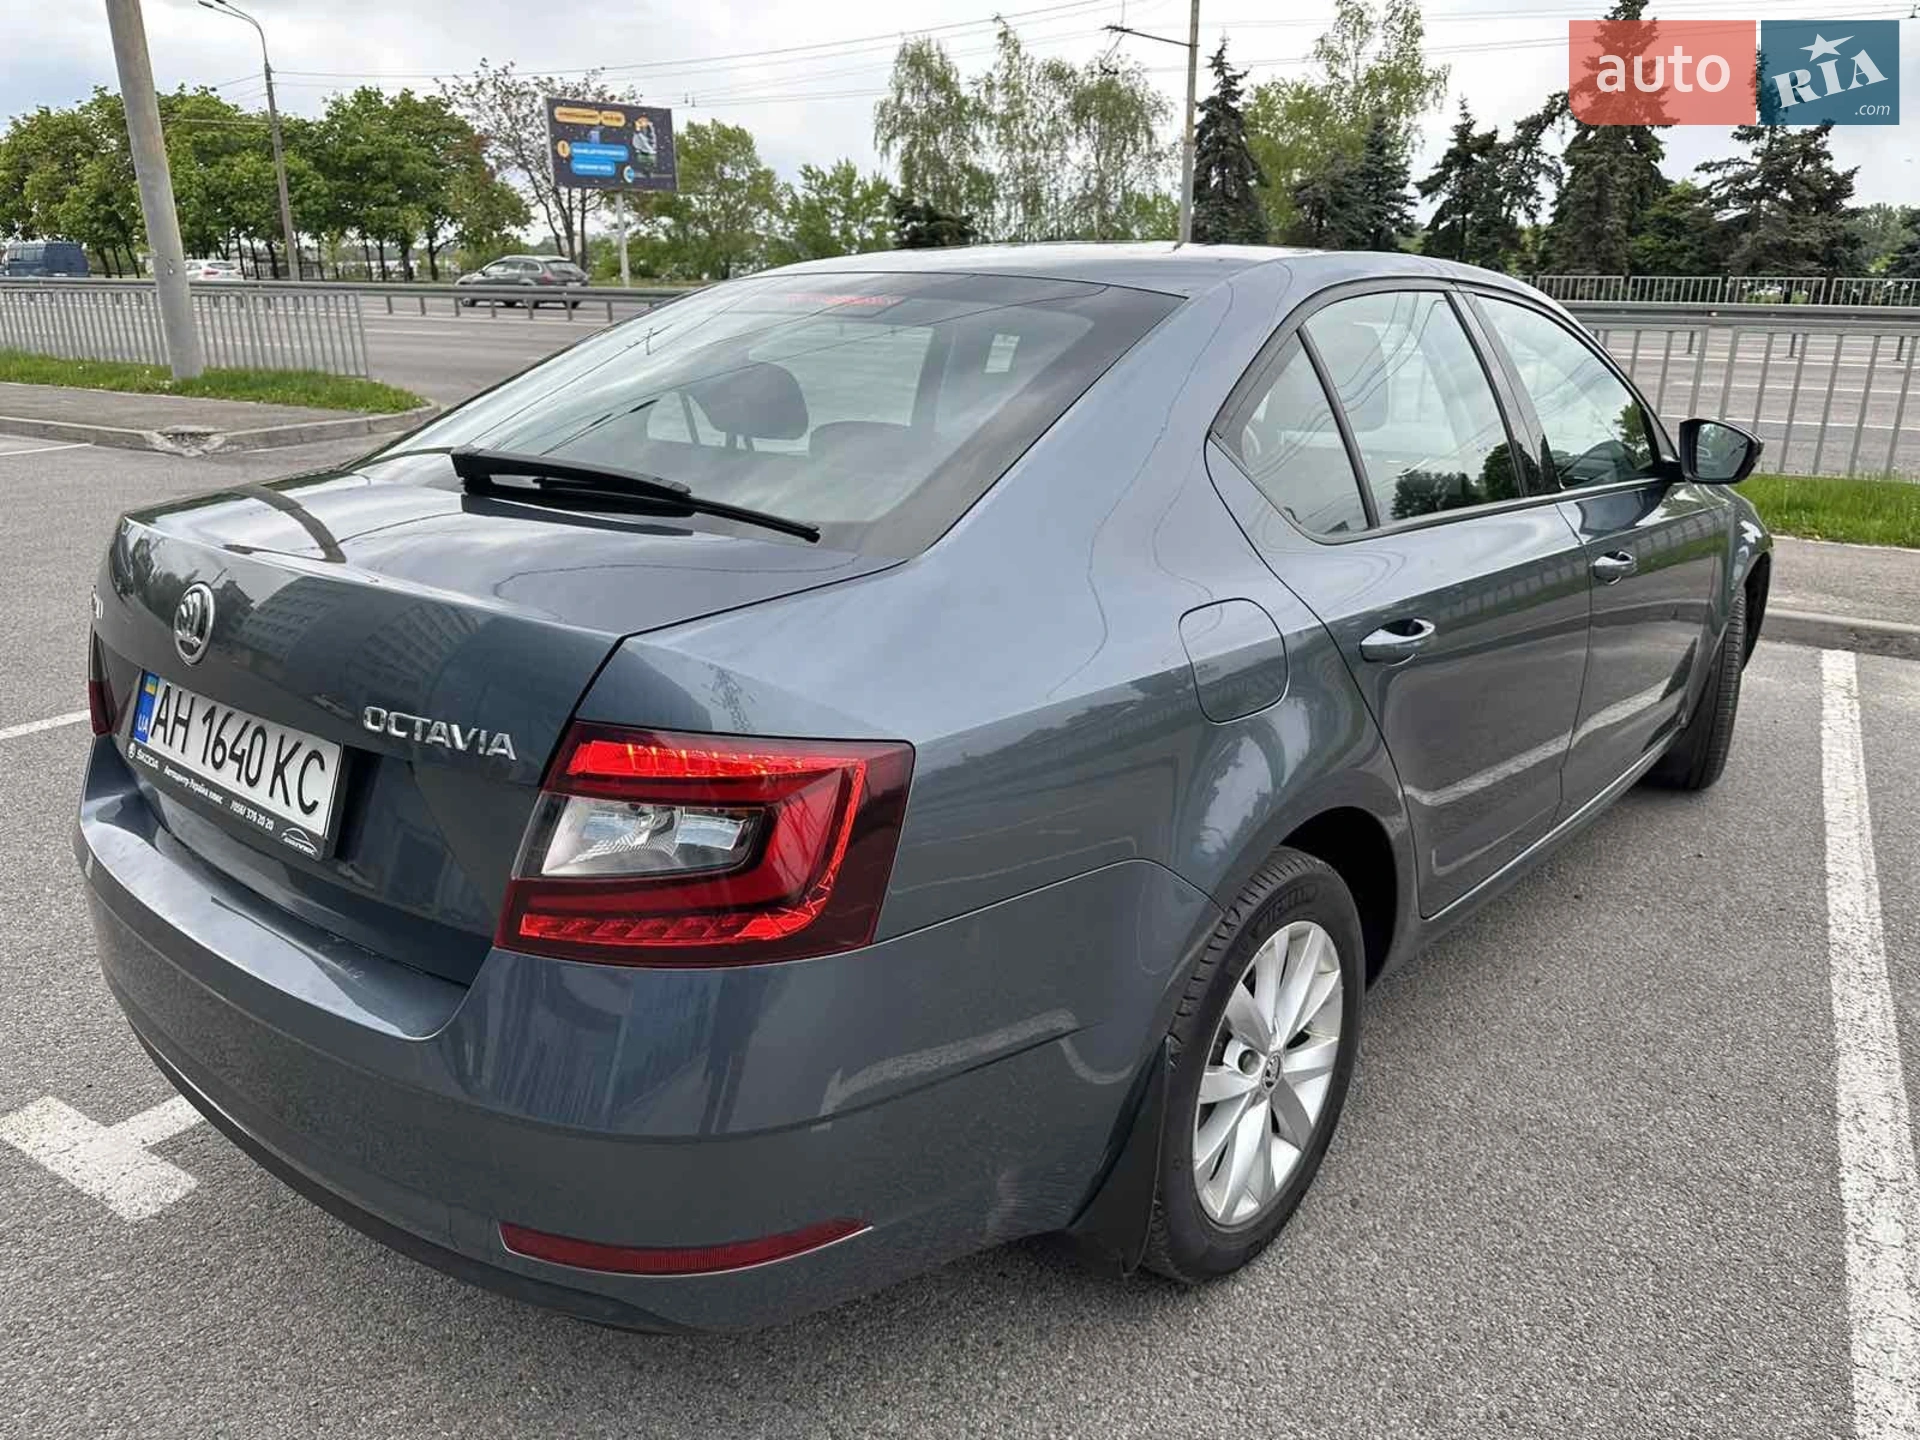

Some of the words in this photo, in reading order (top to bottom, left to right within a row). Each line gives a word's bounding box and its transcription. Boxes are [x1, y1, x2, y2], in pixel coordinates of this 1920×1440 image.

[138, 713, 149, 734] UA
[151, 684, 195, 754] AH
[202, 706, 267, 787] 1640
[268, 733, 326, 816] KC
[363, 706, 517, 760] OCTAVIA
